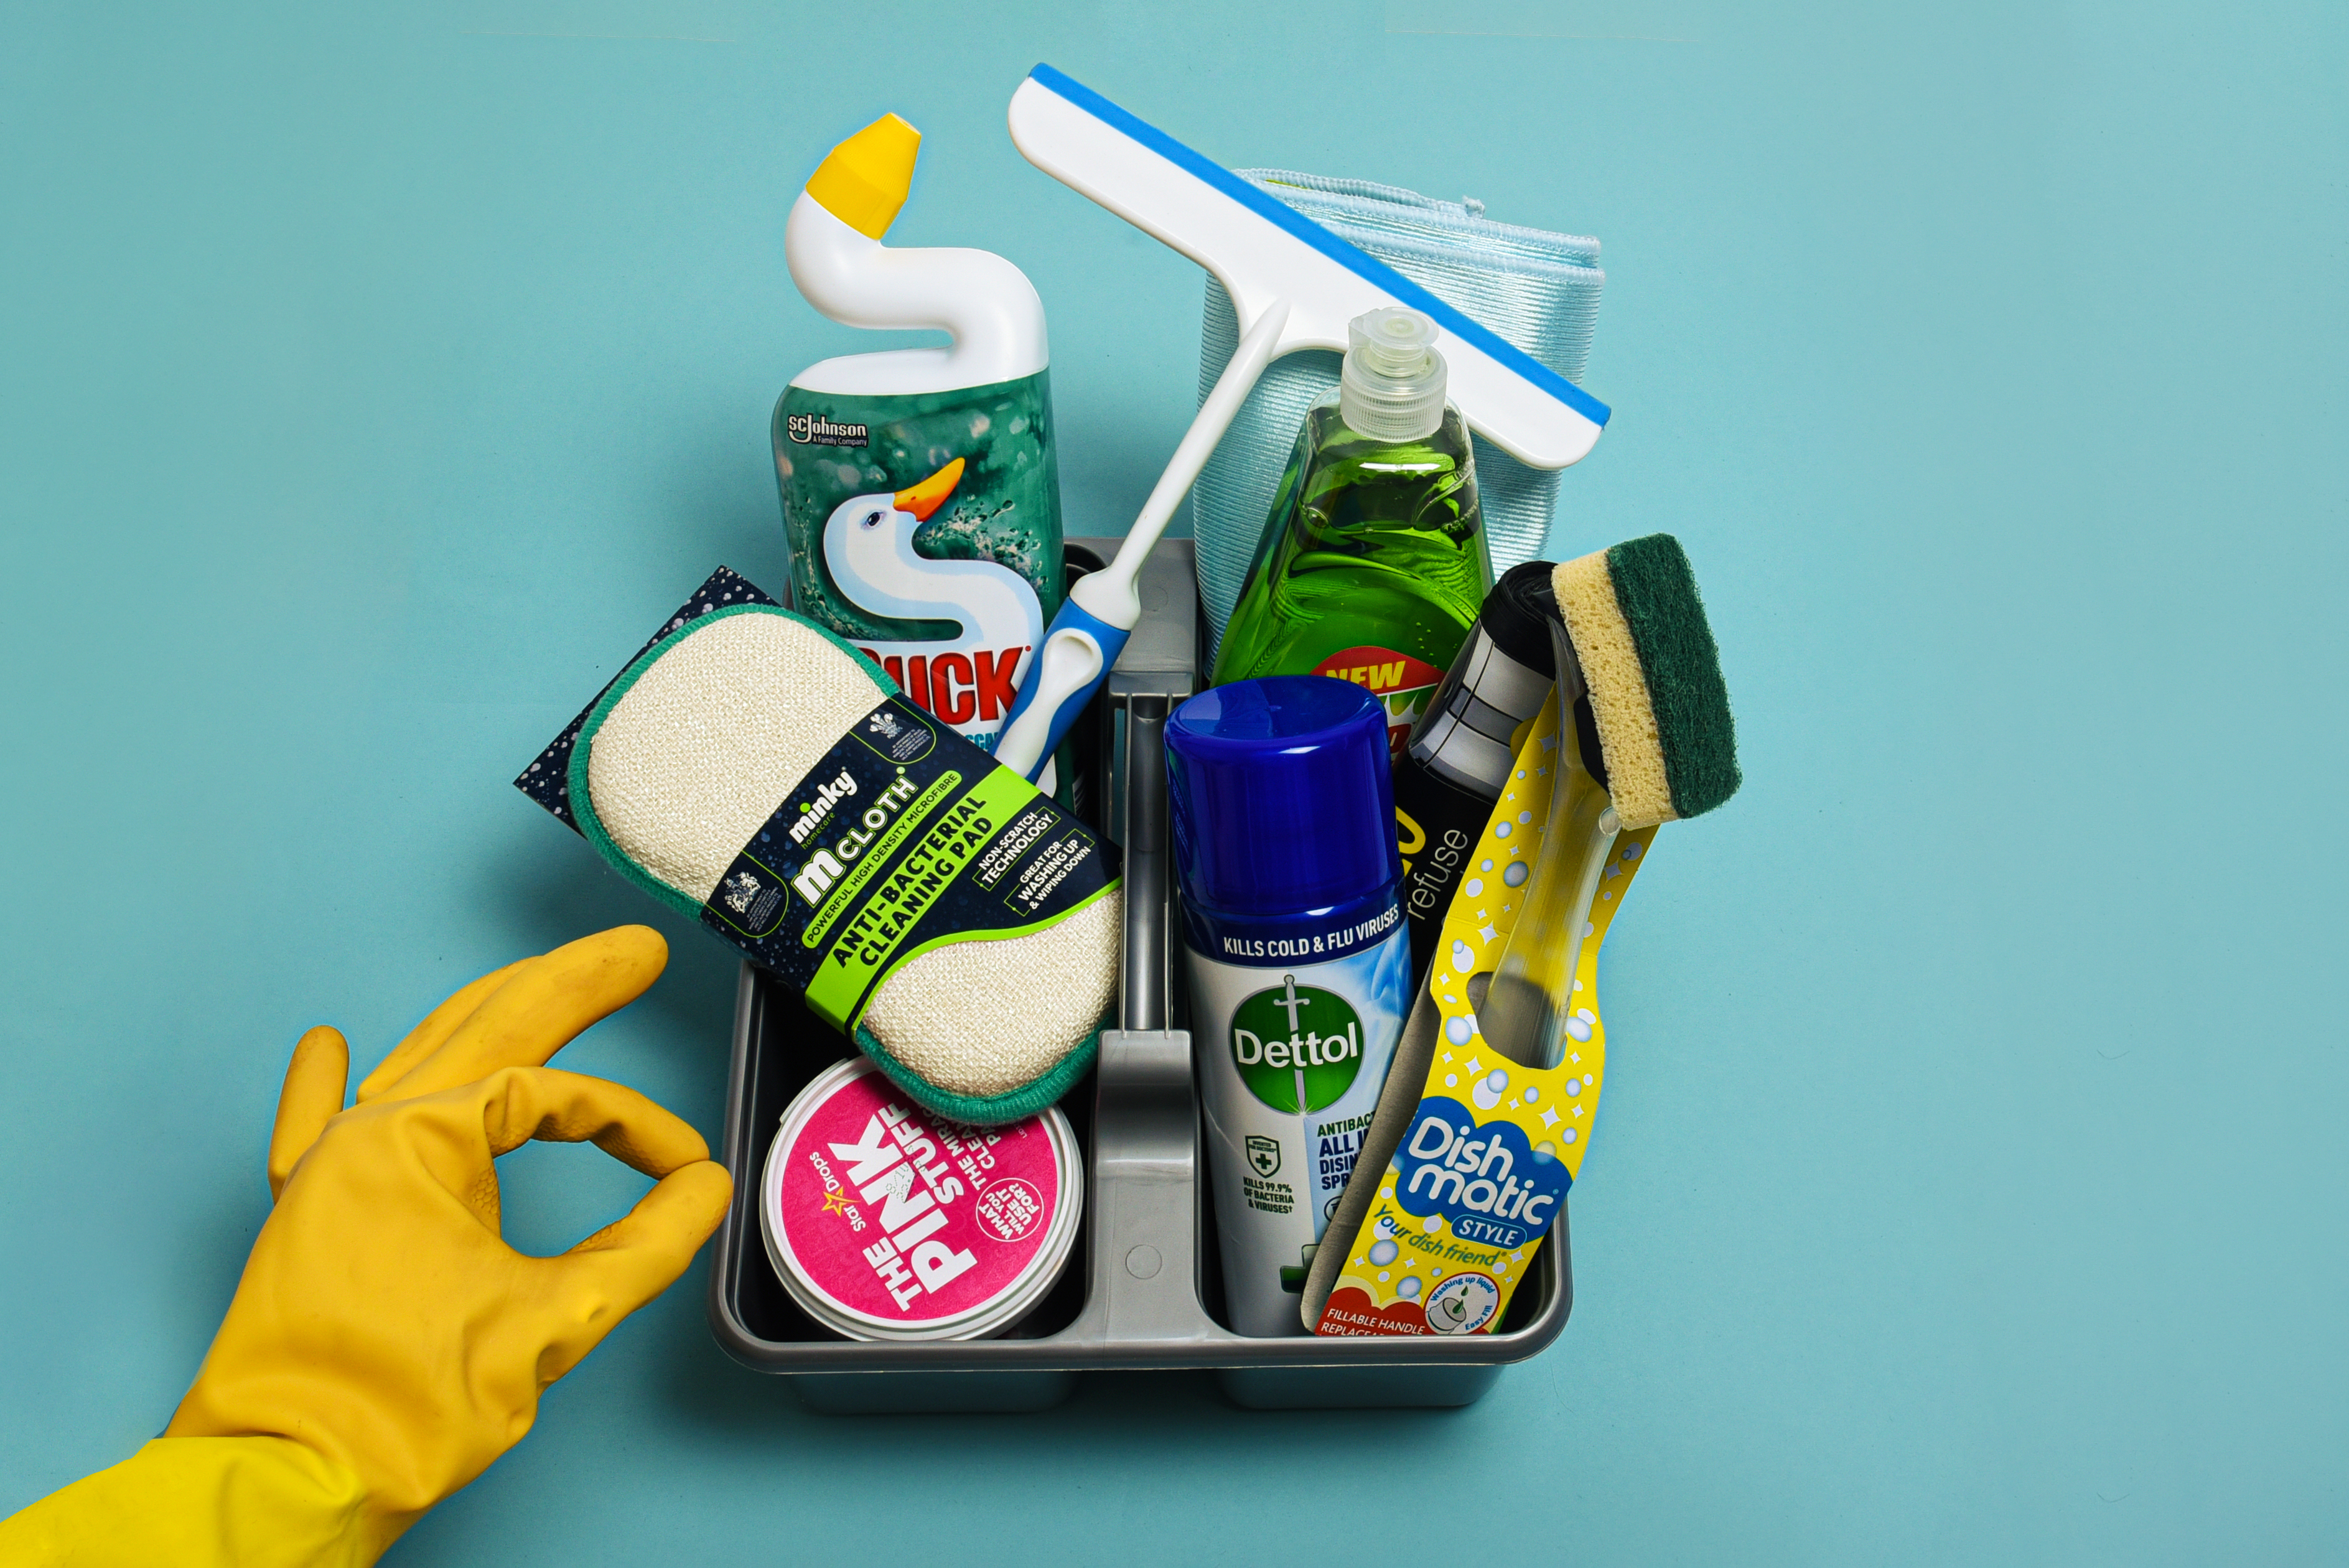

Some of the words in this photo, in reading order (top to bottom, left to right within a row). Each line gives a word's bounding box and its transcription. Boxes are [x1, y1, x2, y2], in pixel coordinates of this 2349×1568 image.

[818, 436, 836, 444] Family
[838, 438, 867, 446] Company
[857, 646, 1024, 725] UCK
[788, 771, 858, 844] minky
[800, 812, 836, 850] homecare
[978, 811, 1038, 870] NON-SCRATCH
[981, 813, 1053, 884] TECHNOLOGY
[807, 887, 853, 943] POWERFUL
[851, 862, 874, 887] HIGH
[871, 822, 908, 862] DENSITY
[906, 773, 958, 824] MICROFIBRE
[1017, 851, 1068, 901] WASHING
[1063, 839, 1078, 854] UP
[1019, 855, 1047, 884] GREAT
[1044, 841, 1063, 859] FOR
[1406, 829, 1469, 921] refuse
[833, 796, 987, 969] ANTI-BACTERIAL
[860, 858, 955, 966] CLEANING
[949, 817, 992, 860] PAD
[1029, 900, 1040, 910] &
[1035, 869, 1067, 902] WIPING
[1063, 846, 1091, 872] DOWN
[1223, 936, 1264, 957] KILLS
[1268, 938, 1309, 957] COLD
[1313, 936, 1325, 953] &
[1327, 927, 1353, 950] FLU
[1355, 903, 1399, 941] VIRUSES
[1234, 1021, 1358, 1068] Dettol
[877, 1103, 964, 1204] STUFF
[981, 1126, 1001, 1147] PA
[1319, 1134, 1355, 1157] ALL
[1408, 1116, 1514, 1182] Dish
[809, 1151, 840, 1193] Drops
[957, 1154, 987, 1191] THE
[1319, 1152, 1360, 1175] DISIN
[1321, 1172, 1350, 1190] SPR
[985, 1192, 1004, 1213] YOU
[995, 1188, 1012, 1202] IT
[1008, 1183, 1040, 1215] FOR?
[1243, 1176, 1264, 1190] KILLS
[1265, 1182, 1292, 1193] 99.9%
[1243, 1187, 1253, 1197] OF
[1254, 1189, 1294, 1205] BACTERIA
[1248, 1198, 1254, 1208] &
[1408, 1164, 1554, 1225] matic
[827, 1114, 978, 1294] PINK
[843, 1205, 866, 1232] Star
[978, 1203, 1014, 1240] WHAT
[1004, 1210, 1025, 1235] WILL
[1007, 1198, 1032, 1226] USE
[1373, 1203, 1413, 1239] Your
[1408, 1233, 1444, 1256] dish
[1459, 1219, 1518, 1246] STYLE
[862, 1236, 923, 1312] THE
[1430, 1277, 1464, 1301] Washing
[1477, 1276, 1495, 1294] liquid
[1327, 1308, 1378, 1327] FILLABLE
[1378, 1318, 1426, 1335] HANDLE
[1465, 1316, 1484, 1330] Easy
[1482, 1305, 1493, 1317] Fill
